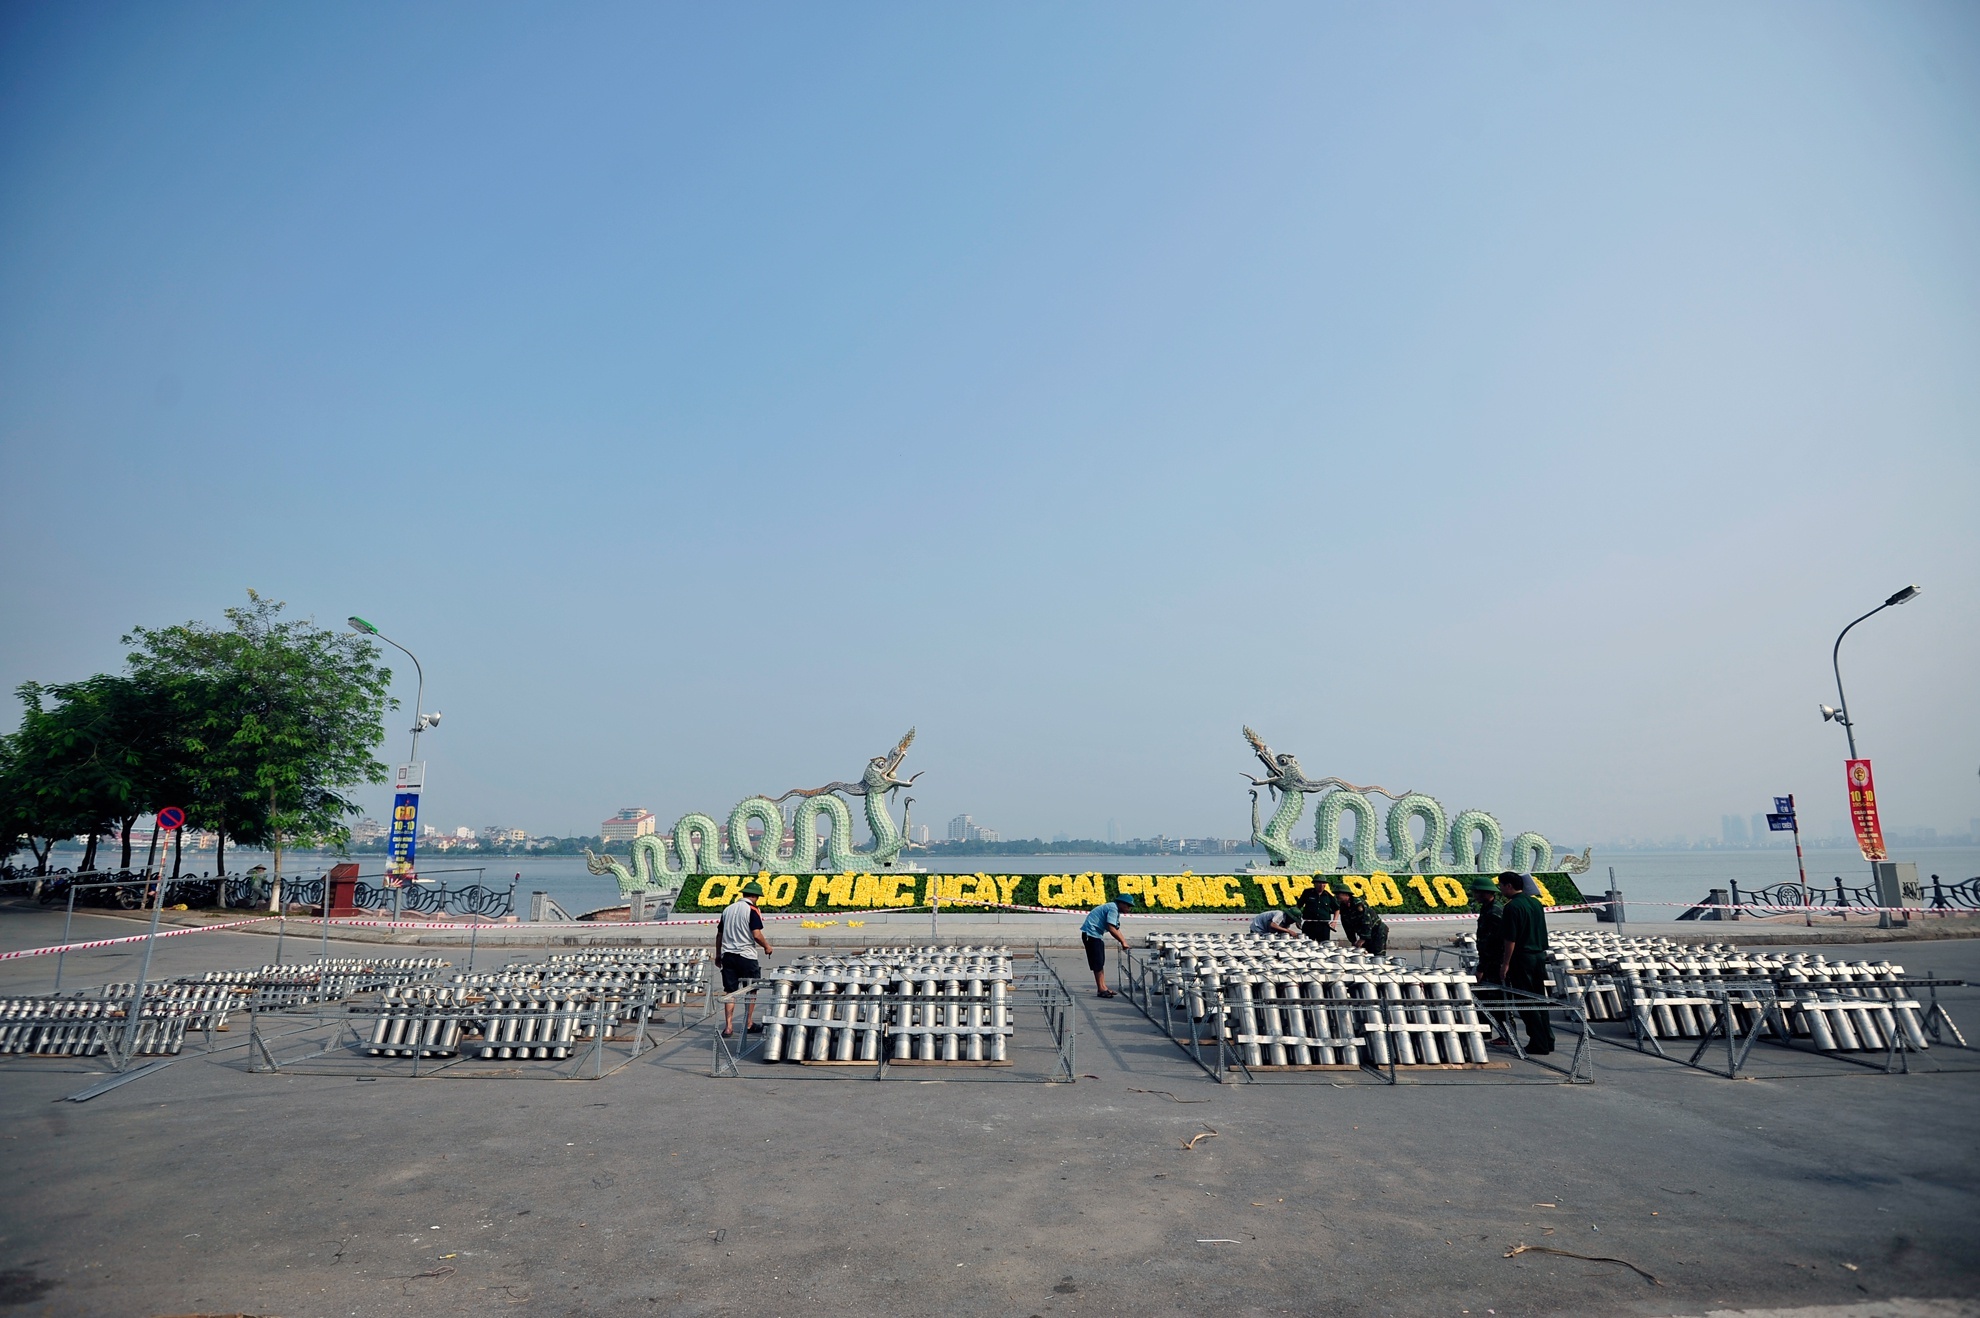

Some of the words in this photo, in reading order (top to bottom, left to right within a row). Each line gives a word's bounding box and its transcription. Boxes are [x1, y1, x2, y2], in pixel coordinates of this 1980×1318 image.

[923, 872, 1022, 907] NGÀY
[1117, 869, 1246, 907] PHÓNG
[1407, 874, 1469, 908] 10
